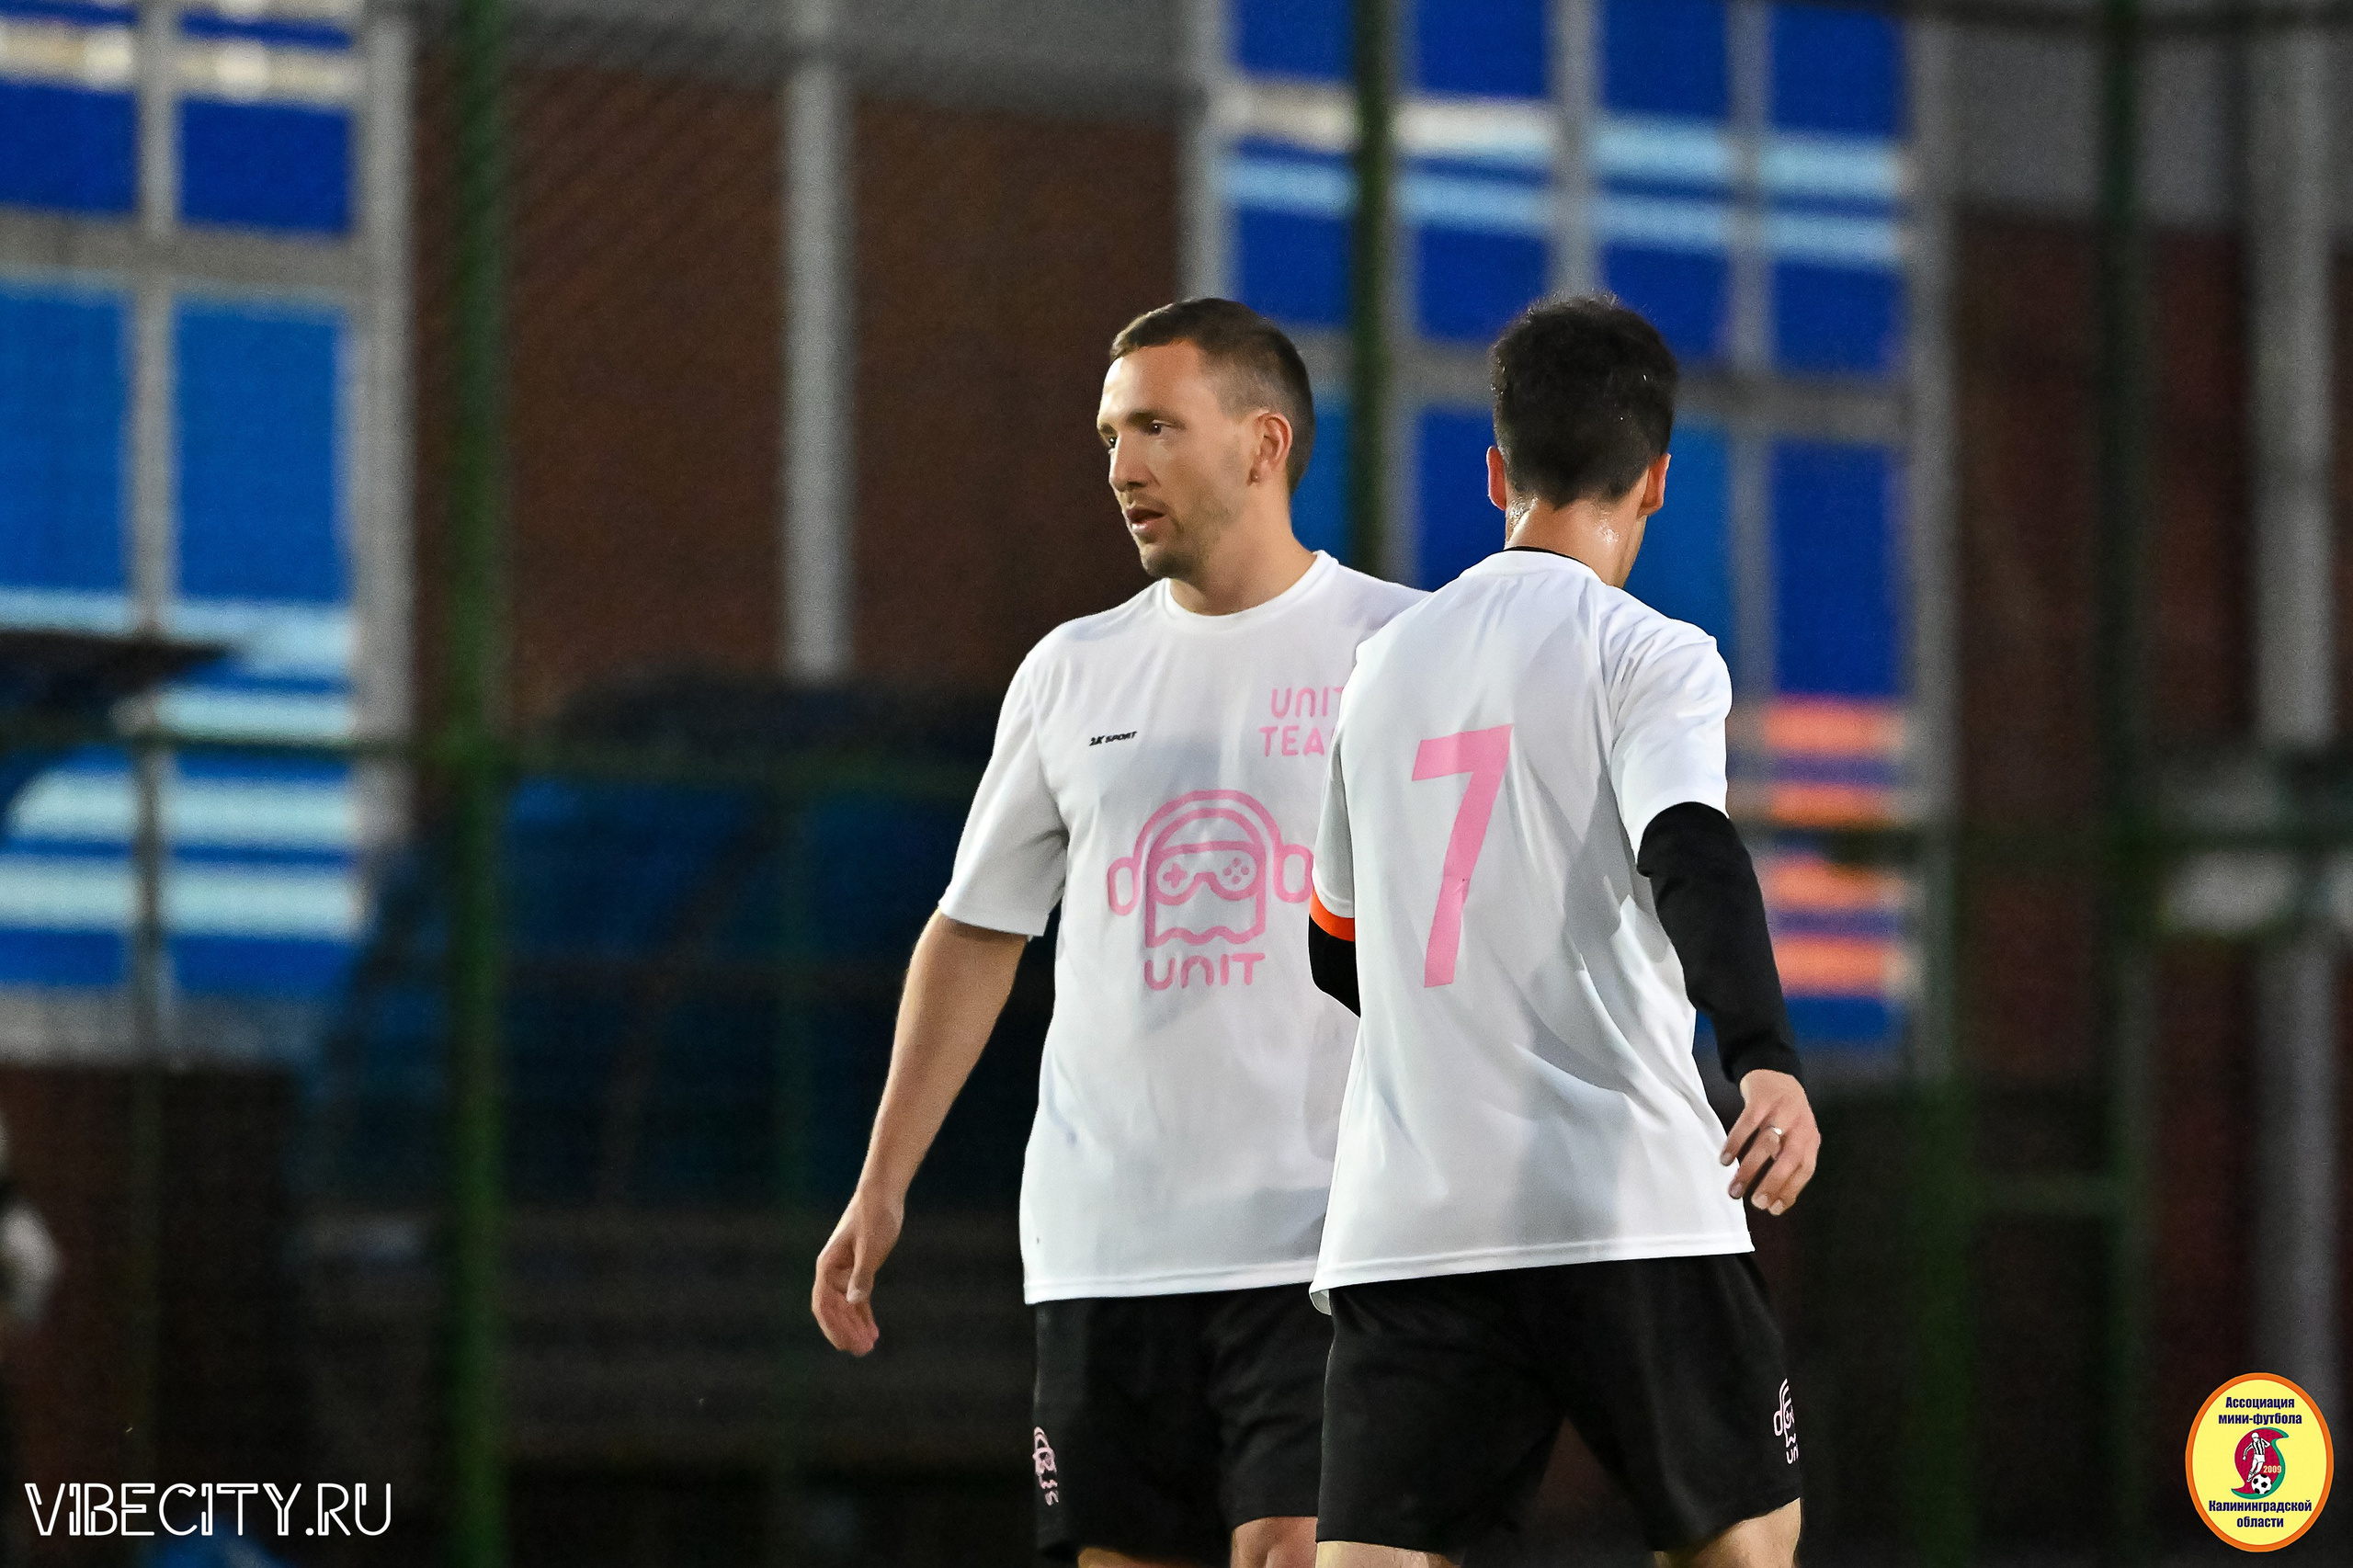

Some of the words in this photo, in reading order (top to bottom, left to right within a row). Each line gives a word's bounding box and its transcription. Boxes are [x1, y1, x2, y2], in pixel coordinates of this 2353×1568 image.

[1270, 687, 1345, 719] UNI
[1105, 731, 1137, 743] SPORT
[1258, 725, 1336, 756] TEA
[1412, 723, 1514, 988] 7
